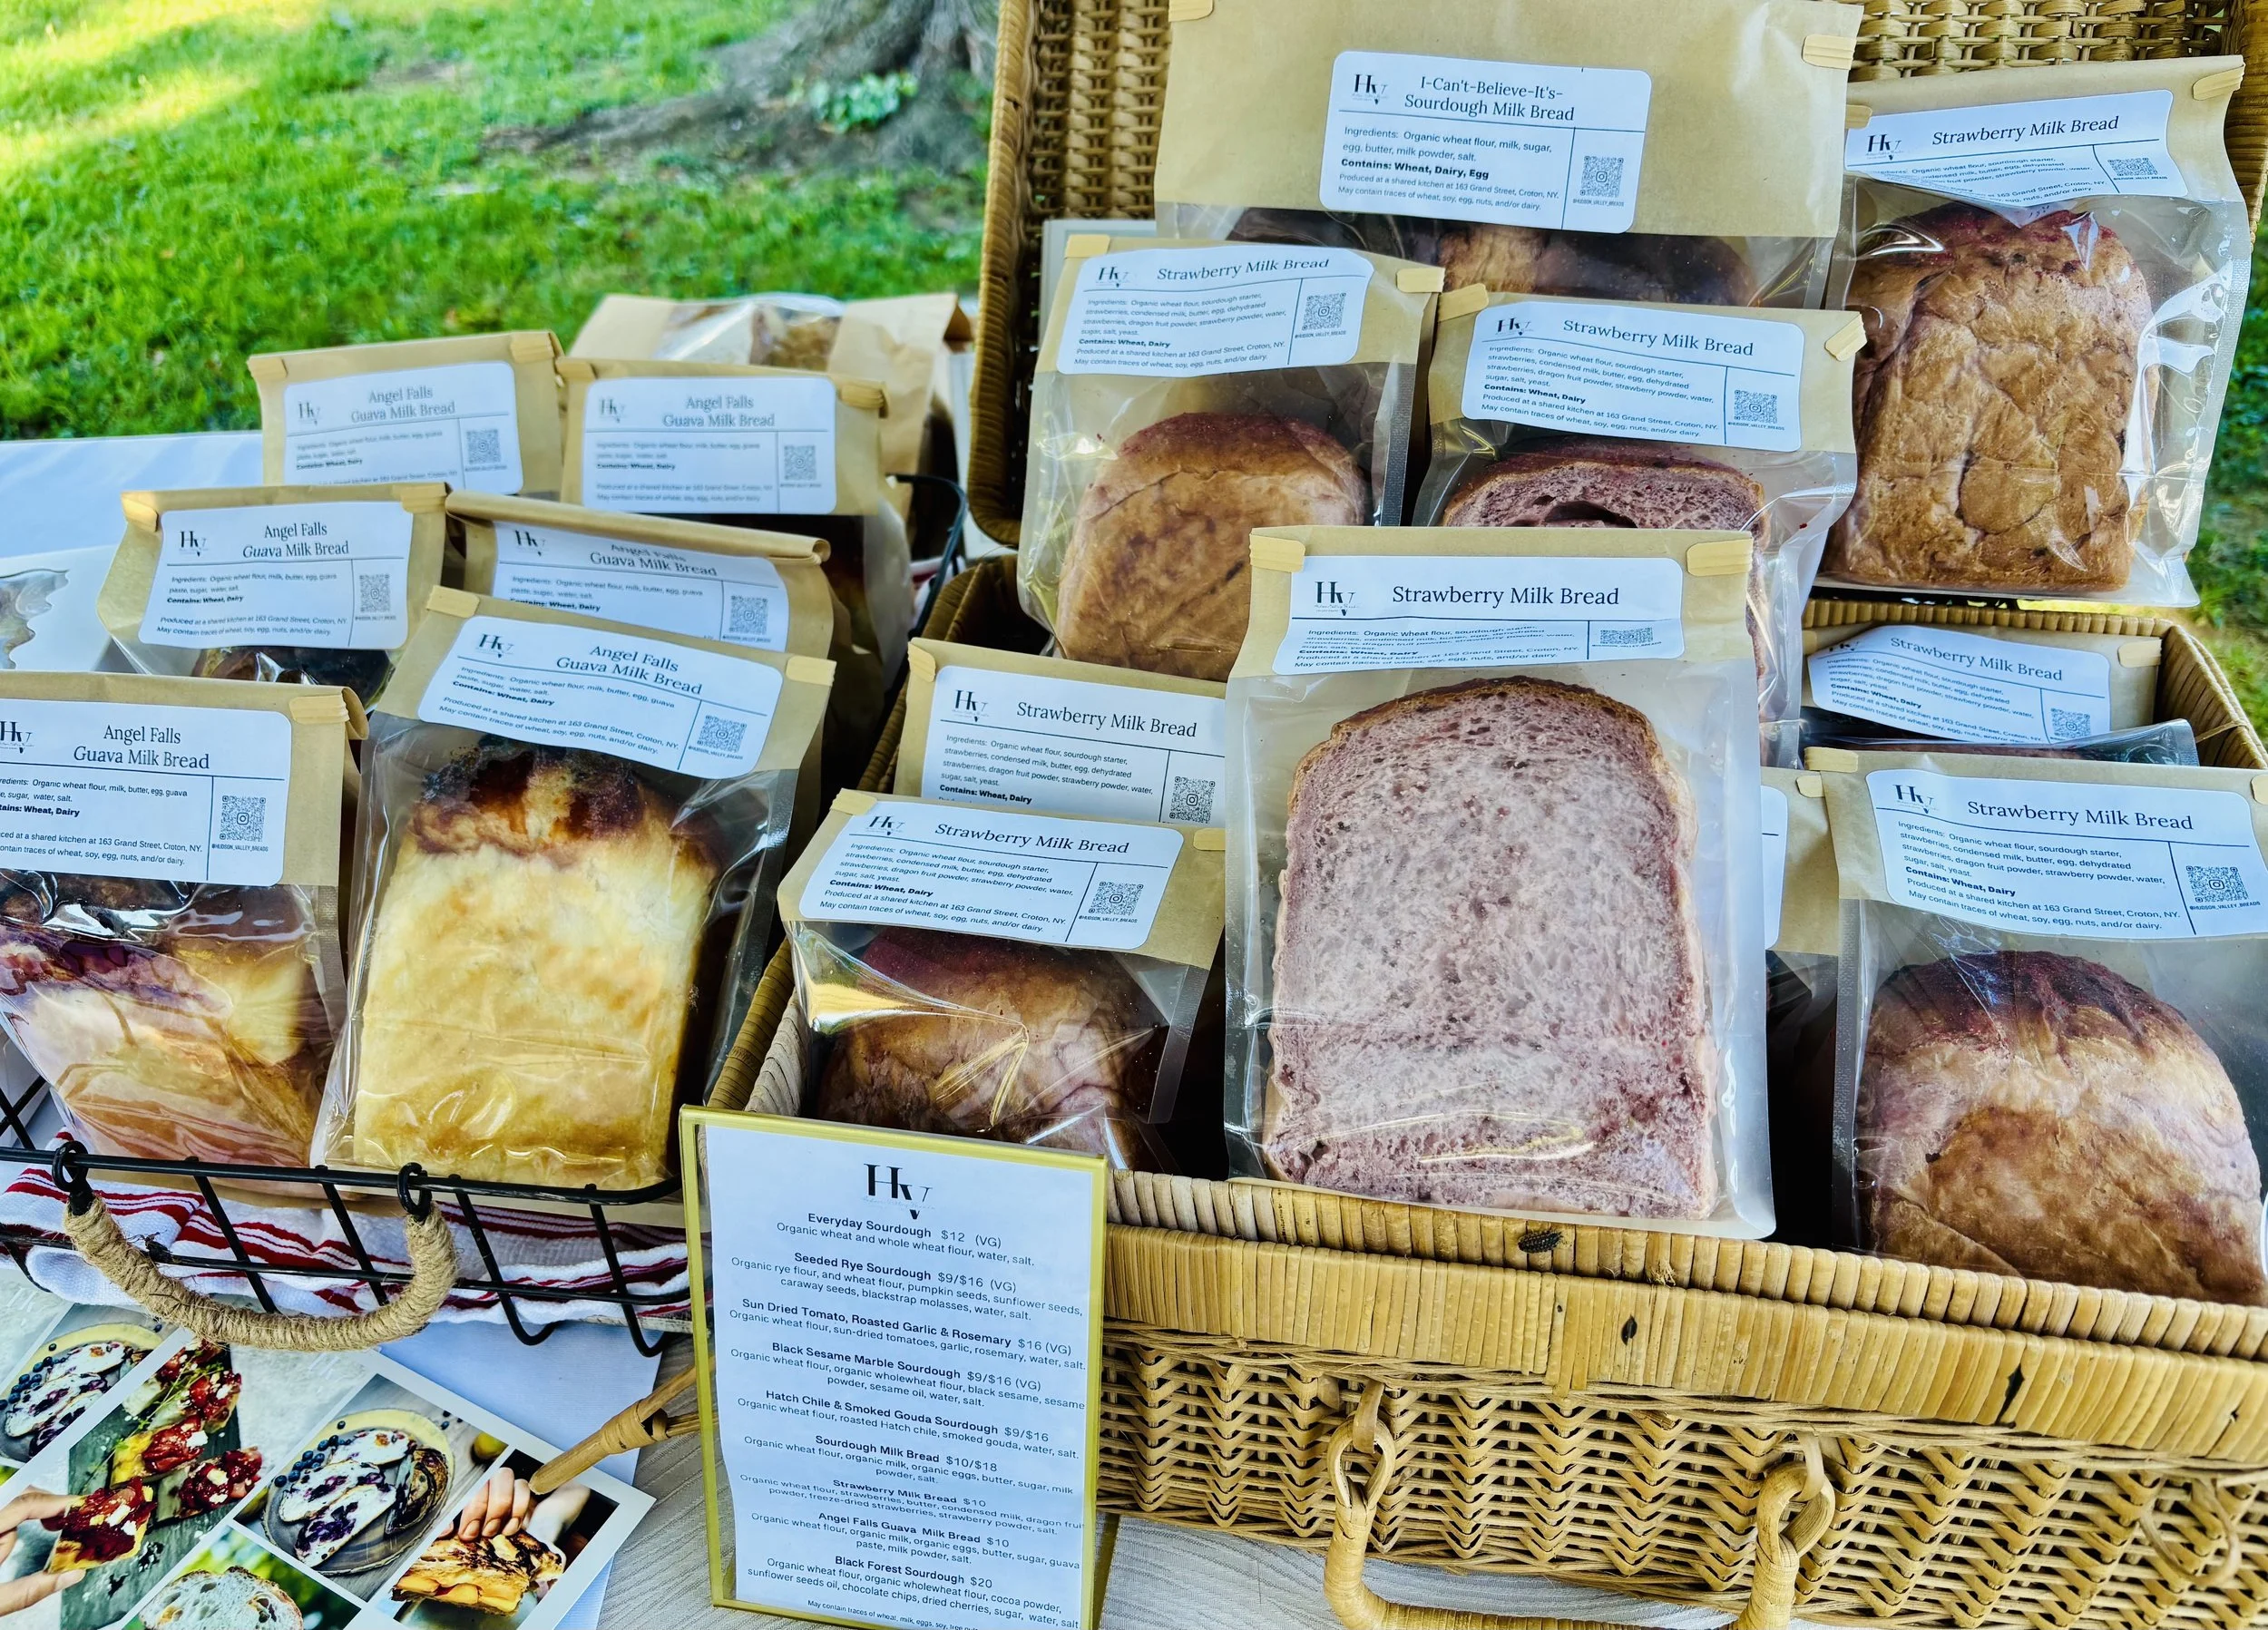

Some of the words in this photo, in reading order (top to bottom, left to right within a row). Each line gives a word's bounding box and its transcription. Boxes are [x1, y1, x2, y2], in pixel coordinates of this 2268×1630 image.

[1404, 93, 1488, 118] Sourdough
[1492, 102, 1526, 118] Milk
[1530, 104, 1575, 122] Bread
[1344, 126, 1399, 139] Ingredients:
[1403, 131, 1441, 143] Organic
[1442, 134, 1472, 146] wheat
[1473, 137, 1497, 149] flour,
[1499, 140, 1521, 151] milk,
[1522, 143, 1552, 154] sugar,
[1931, 127, 2027, 145] Strawberry
[2029, 120, 2067, 137] Milk
[2069, 115, 2119, 133] Bread
[1342, 143, 1363, 154] egg,
[1364, 142, 1394, 156] butter,
[1396, 146, 1416, 156] milk
[1417, 150, 1456, 161] powder,
[1457, 151, 1477, 162] salt.
[1341, 158, 1392, 170] Contains:
[1393, 161, 1432, 175] Wheat,
[1434, 165, 1467, 179] Dairy,
[1469, 169, 1490, 181] Egg
[1157, 265, 1242, 280] Strawberry
[1245, 259, 1279, 273] Milk
[1283, 259, 1330, 270] Bread
[1563, 319, 1658, 348] Strawberry
[1662, 333, 1699, 349] Milk
[1704, 337, 1754, 356] Bread
[368, 387, 404, 405] Angel
[406, 385, 434, 401] Falls
[685, 395, 723, 414] Angel
[725, 395, 755, 409] Falls
[1483, 384, 1527, 394] Contains:
[1528, 388, 1560, 400] Wheat,
[1561, 394, 1587, 405] Dairy
[350, 409, 387, 424] Guava
[389, 404, 417, 420] Milk
[419, 400, 455, 417] Bread
[661, 414, 705, 428] Guava
[708, 413, 736, 427] Milk
[738, 413, 775, 427] Bread
[264, 522, 298, 542] Angel
[300, 521, 327, 537] Falls
[242, 545, 282, 559] Guava
[286, 542, 312, 557] Milk
[314, 540, 349, 556] Bread
[590, 551, 636, 568] Guava
[638, 556, 671, 571] Milk
[674, 561, 718, 576] Bread
[1393, 585, 1505, 610] Strawberry
[1510, 586, 1554, 604] Milk
[1559, 587, 1619, 605] Bread
[589, 646, 639, 662] Angel
[641, 653, 679, 672] Falls
[1890, 637, 1976, 669] Strawberry
[1980, 655, 2013, 673] Milk
[2018, 663, 2062, 681] Bread
[556, 657, 608, 673] Guava
[611, 663, 650, 681] Milk
[653, 672, 703, 695] Bread
[1016, 701, 1107, 731] Strawberry
[1110, 713, 1147, 732] Milk
[1149, 717, 1198, 737] Bread
[103, 724, 146, 747] Angel
[150, 727, 181, 745] Falls
[73, 746, 123, 764] Guava
[127, 748, 160, 766] Milk
[162, 751, 210, 769] Bread
[939, 784, 978, 796] Contains:
[979, 789, 1008, 802] Wheat,
[1009, 794, 1032, 805] Dairy
[24, 805, 54, 816] Wheat,
[55, 807, 81, 818] Dairy
[1968, 800, 2079, 826] Strawberry
[2085, 809, 2130, 825] Milk
[2134, 812, 2195, 830] Bread
[934, 824, 1032, 848] Strawberry
[1035, 835, 1074, 850] Milk
[1077, 839, 1130, 854] Bread
[829, 879, 873, 890] Contains:
[874, 883, 906, 894] Wheat,
[907, 888, 934, 898] Dairy
[1905, 865, 1950, 883] Contains:
[1950, 877, 1987, 893] Wheat,
[1988, 885, 2016, 898] Dairy
[1907, 877, 1947, 893] Produced
[1965, 893, 1995, 905] shared
[1997, 899, 2030, 910] kitchen
[2043, 903, 2060, 913] 163
[2062, 905, 2092, 914] Grand
[2094, 907, 2125, 917] Street,
[2126, 910, 2162, 919] Croton,
[777, 1222, 818, 1236] Organic
[820, 1228, 853, 1241] wheat
[855, 1234, 875, 1244] and
[877, 1236, 910, 1248] whole
[912, 1241, 945, 1254] wheat
[947, 1244, 974, 1259] flour,
[977, 1251, 1010, 1264] water,
[1012, 1256, 1035, 1266] salt.
[807, 1213, 863, 1231] Everyday
[865, 1220, 932, 1239] Sourdough
[941, 1229, 965, 1243] $12
[975, 1234, 1002, 1250] (VG)
[794, 1252, 838, 1267] Seeded
[841, 1258, 864, 1273] Rye
[866, 1262, 932, 1282] Sourdough
[937, 1272, 983, 1288] $9/$16
[990, 1278, 1016, 1293] (VG)
[742, 1298, 765, 1311] Sun
[767, 1302, 798, 1315] Dried
[800, 1306, 848, 1324] Tomato,
[851, 1313, 900, 1330] Roasted
[903, 1322, 937, 1335] Garlic
[940, 1327, 950, 1337] &
[952, 1328, 1012, 1349] Rosemary
[1018, 1338, 1042, 1351] $16
[1045, 1342, 1071, 1357] (VG)
[772, 1342, 804, 1355] Black
[806, 1347, 852, 1362] Sesame
[854, 1354, 894, 1369] Marble
[897, 1361, 961, 1380] Sourdough
[966, 1371, 1012, 1387] $9/$16
[1015, 1378, 1041, 1392] (VG)
[766, 1390, 799, 1403] Hatch
[801, 1395, 831, 1409] Chile
[833, 1400, 843, 1410] &
[845, 1401, 891, 1418] Smoked
[894, 1410, 933, 1424] Gouda
[934, 1416, 999, 1435] Sourdough
[1004, 1426, 1049, 1442] $9/$16
[815, 1435, 877, 1454] Sourdough
[880, 1445, 904, 1458] Milk
[906, 1449, 940, 1463] Bread
[945, 1455, 998, 1472] $10/$18
[833, 1479, 894, 1497] Strawberry
[897, 1488, 922, 1499] Milk
[924, 1493, 957, 1504] Bread
[963, 1498, 986, 1508] $10
[818, 1512, 850, 1524] Angel
[853, 1517, 879, 1528] Falls
[881, 1521, 917, 1534] Guava
[922, 1528, 945, 1538] Milk
[948, 1531, 981, 1544] Bread
[986, 1537, 1010, 1548] $10
[835, 1555, 865, 1568] Black
[867, 1560, 903, 1575] Forest
[904, 1566, 964, 1586] Sourdough
[970, 1576, 992, 1589] $20
